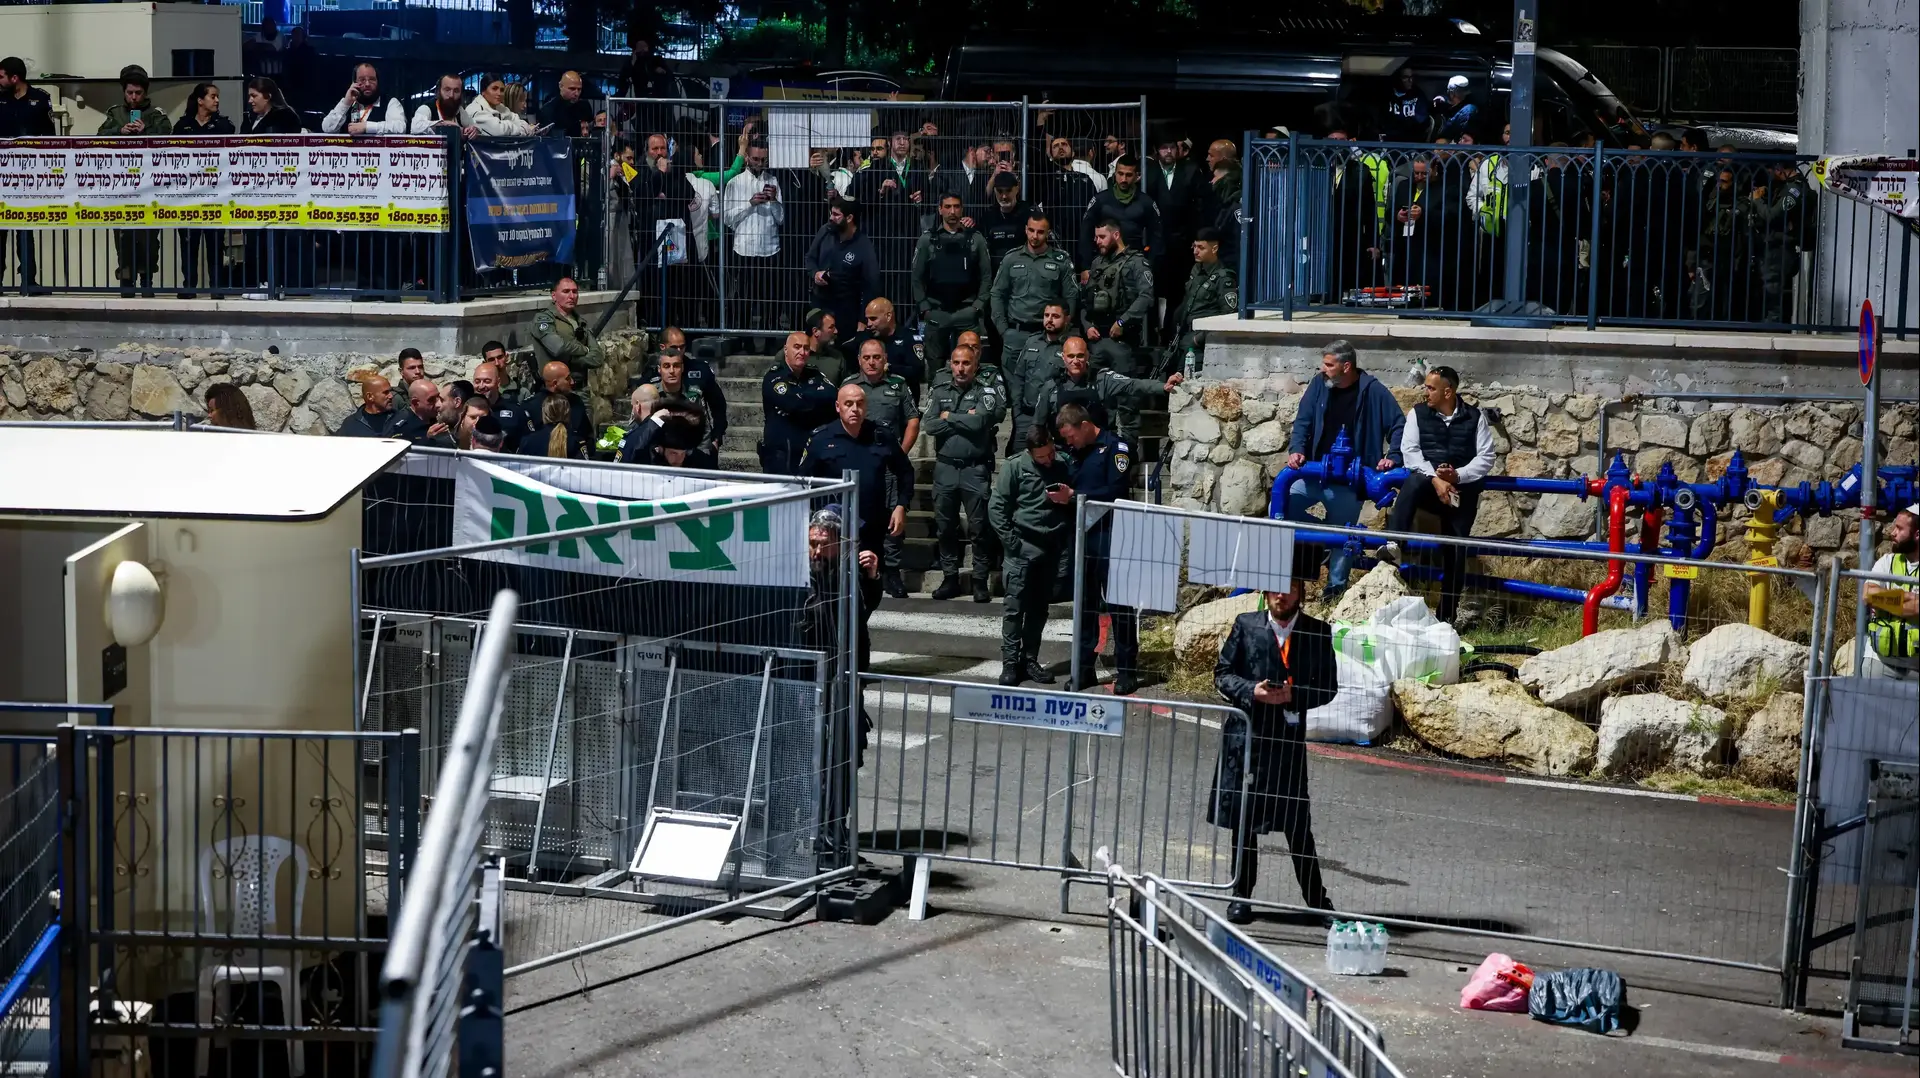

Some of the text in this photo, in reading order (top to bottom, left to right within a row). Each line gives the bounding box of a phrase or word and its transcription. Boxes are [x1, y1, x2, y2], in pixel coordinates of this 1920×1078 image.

[75, 209, 145, 221] 1800.350.330
[153, 208, 221, 221] 1800.350.330
[230, 208, 298, 221] 1800.350.330
[307, 208, 379, 222] 1800.350.330
[491, 477, 770, 570] יציאה
[399, 629, 422, 638] קשת
[991, 694, 1087, 719] קשת במות
[1256, 959, 1281, 991] קשת
